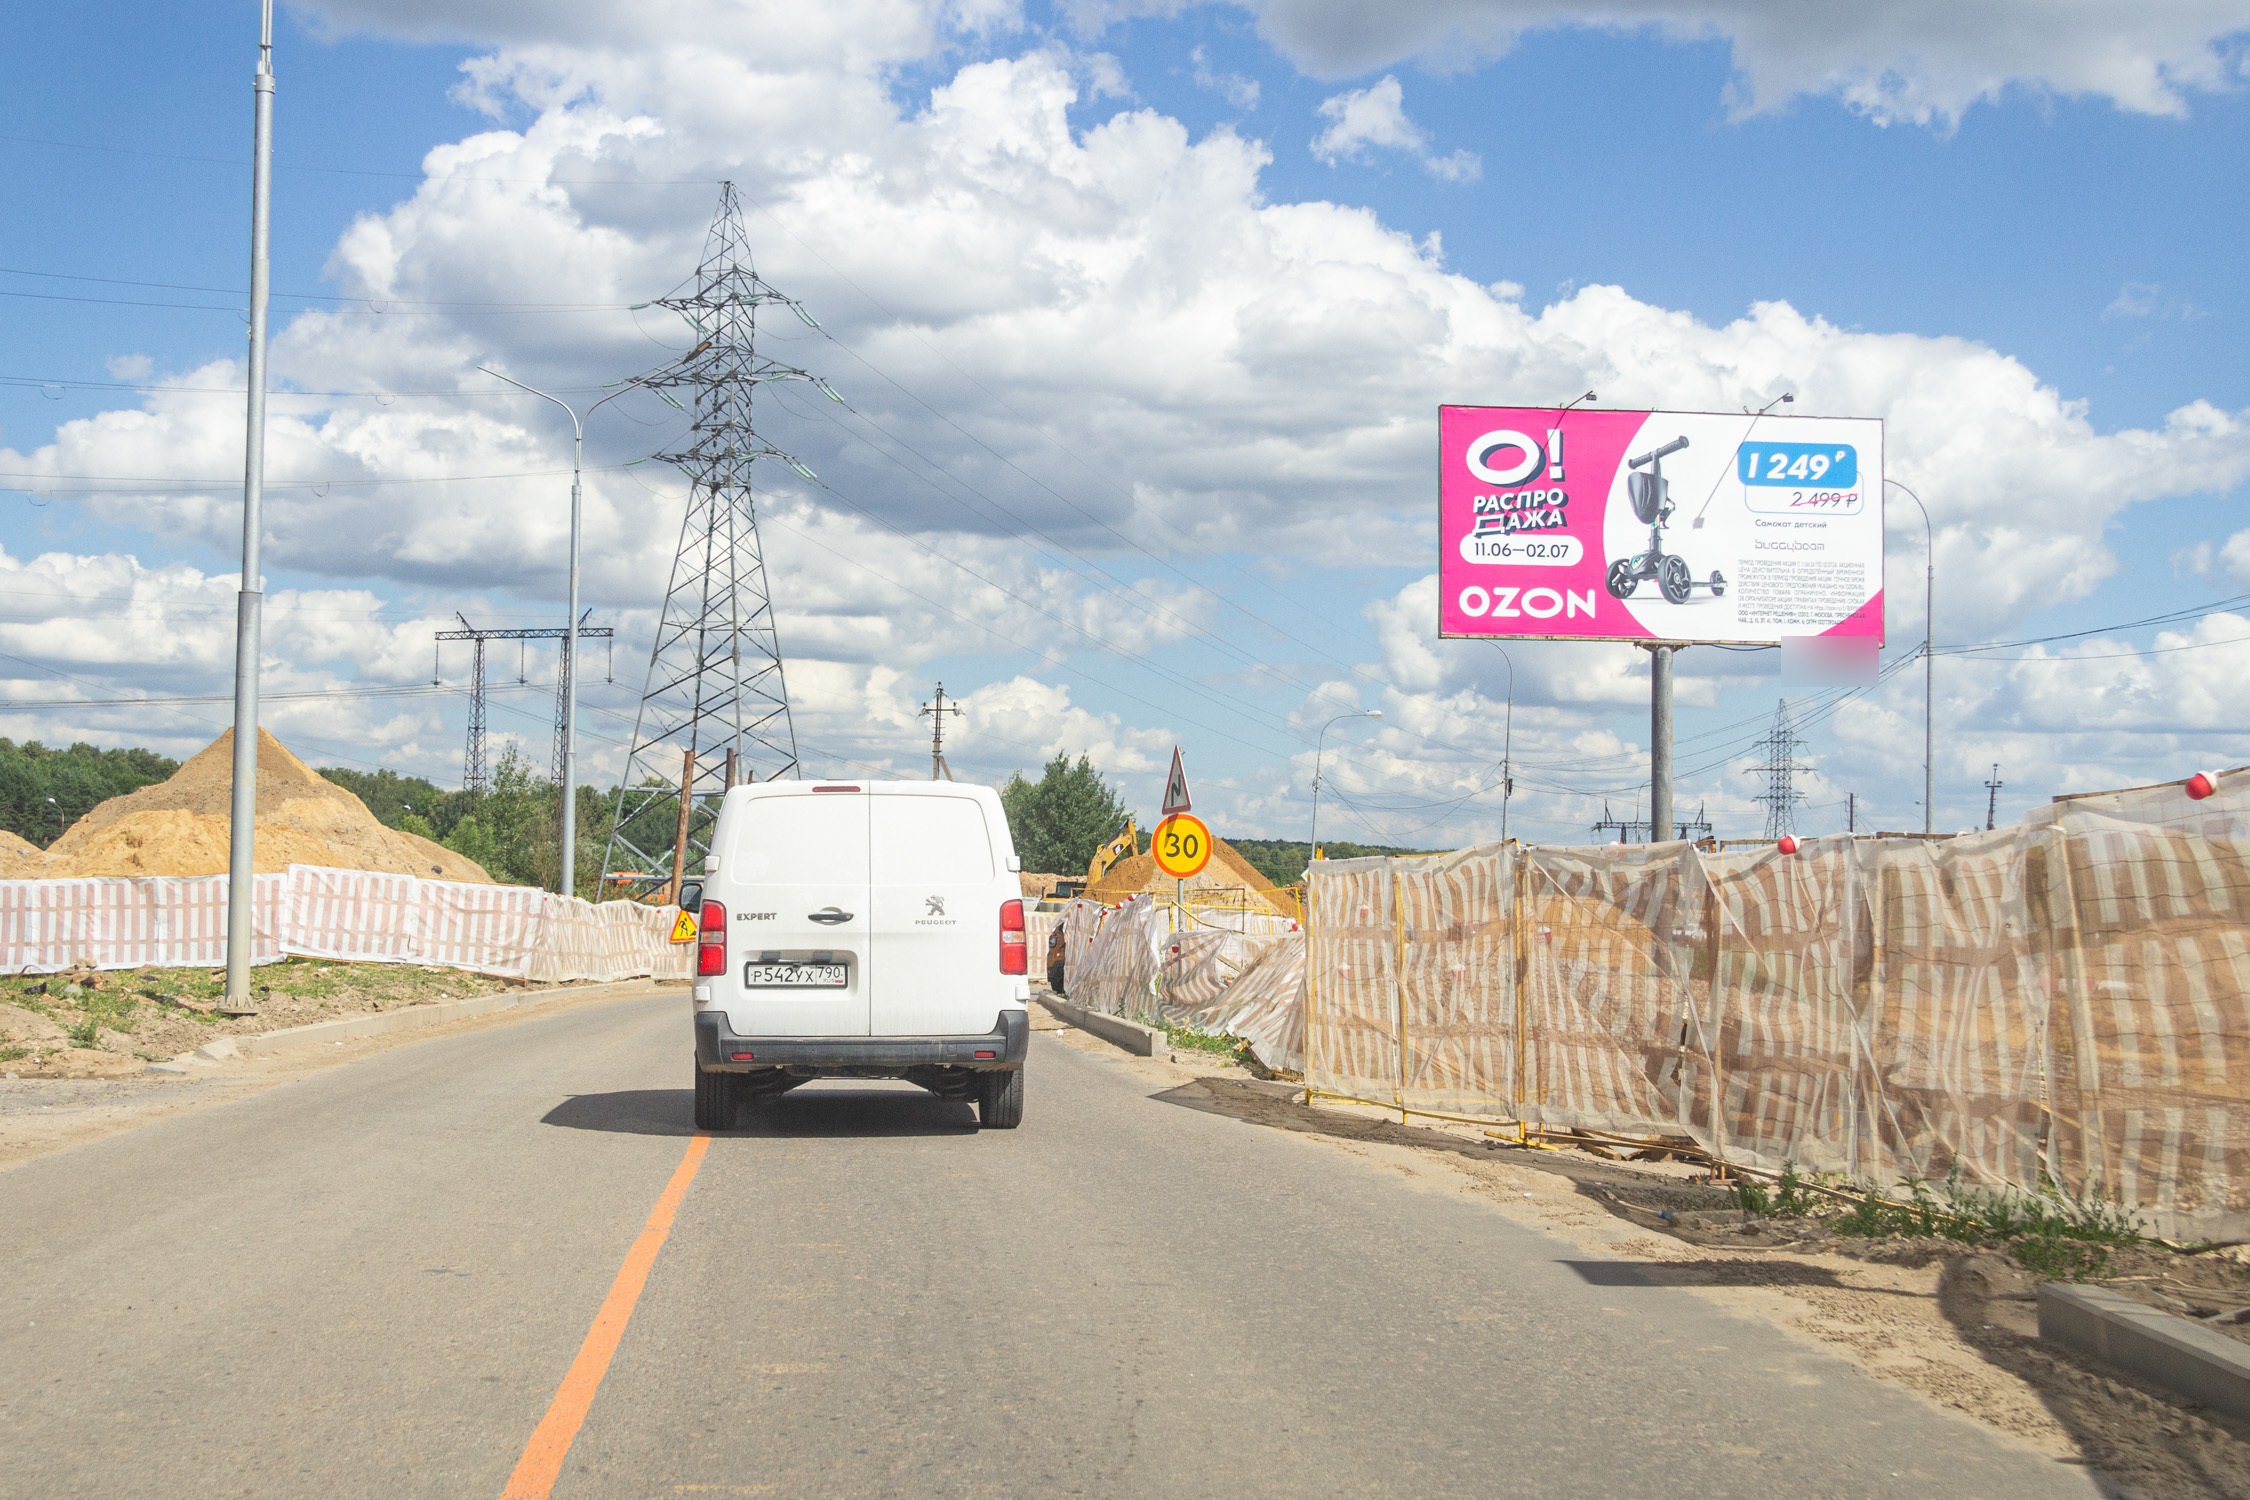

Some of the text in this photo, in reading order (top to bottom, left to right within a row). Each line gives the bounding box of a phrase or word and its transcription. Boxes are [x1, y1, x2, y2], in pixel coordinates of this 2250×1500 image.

[1767, 453, 1830, 480] 249
[1473, 488, 1565, 513] РАСПРО
[1808, 492, 1841, 507] 499
[1472, 508, 1563, 535] ДАЖА
[1754, 519, 1791, 528] Самокат
[1459, 586, 1596, 619] OZON
[1166, 833, 1198, 858] 30
[736, 912, 778, 921] EXPERT
